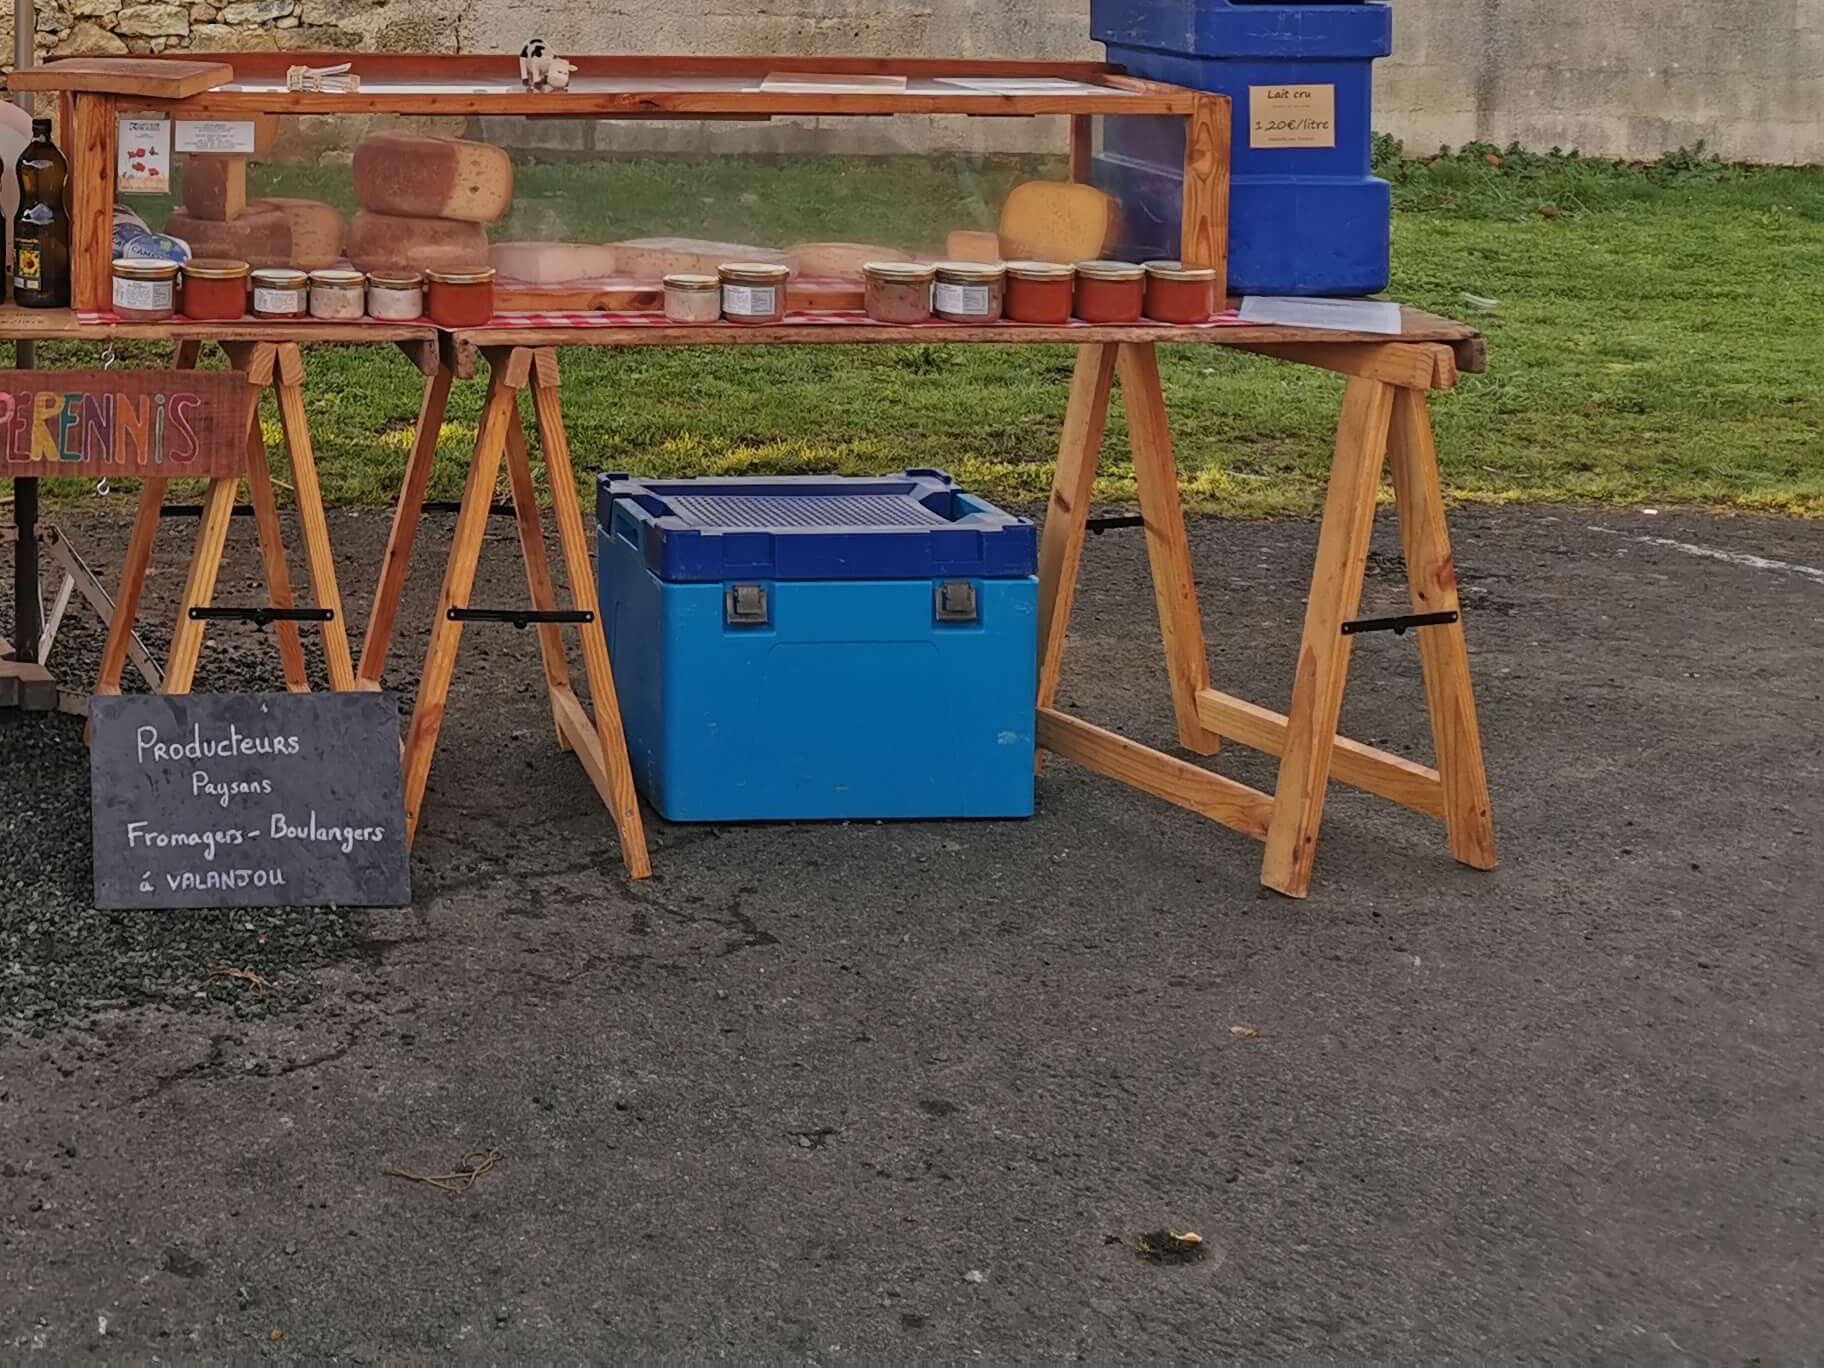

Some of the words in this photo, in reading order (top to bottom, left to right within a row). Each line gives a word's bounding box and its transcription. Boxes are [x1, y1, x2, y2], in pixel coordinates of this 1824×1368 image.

[1267, 88, 1289, 99] Lait
[1293, 90, 1311, 99] cru
[192, 770, 272, 808] Paysans
[166, 868, 287, 892] VALANJOU
